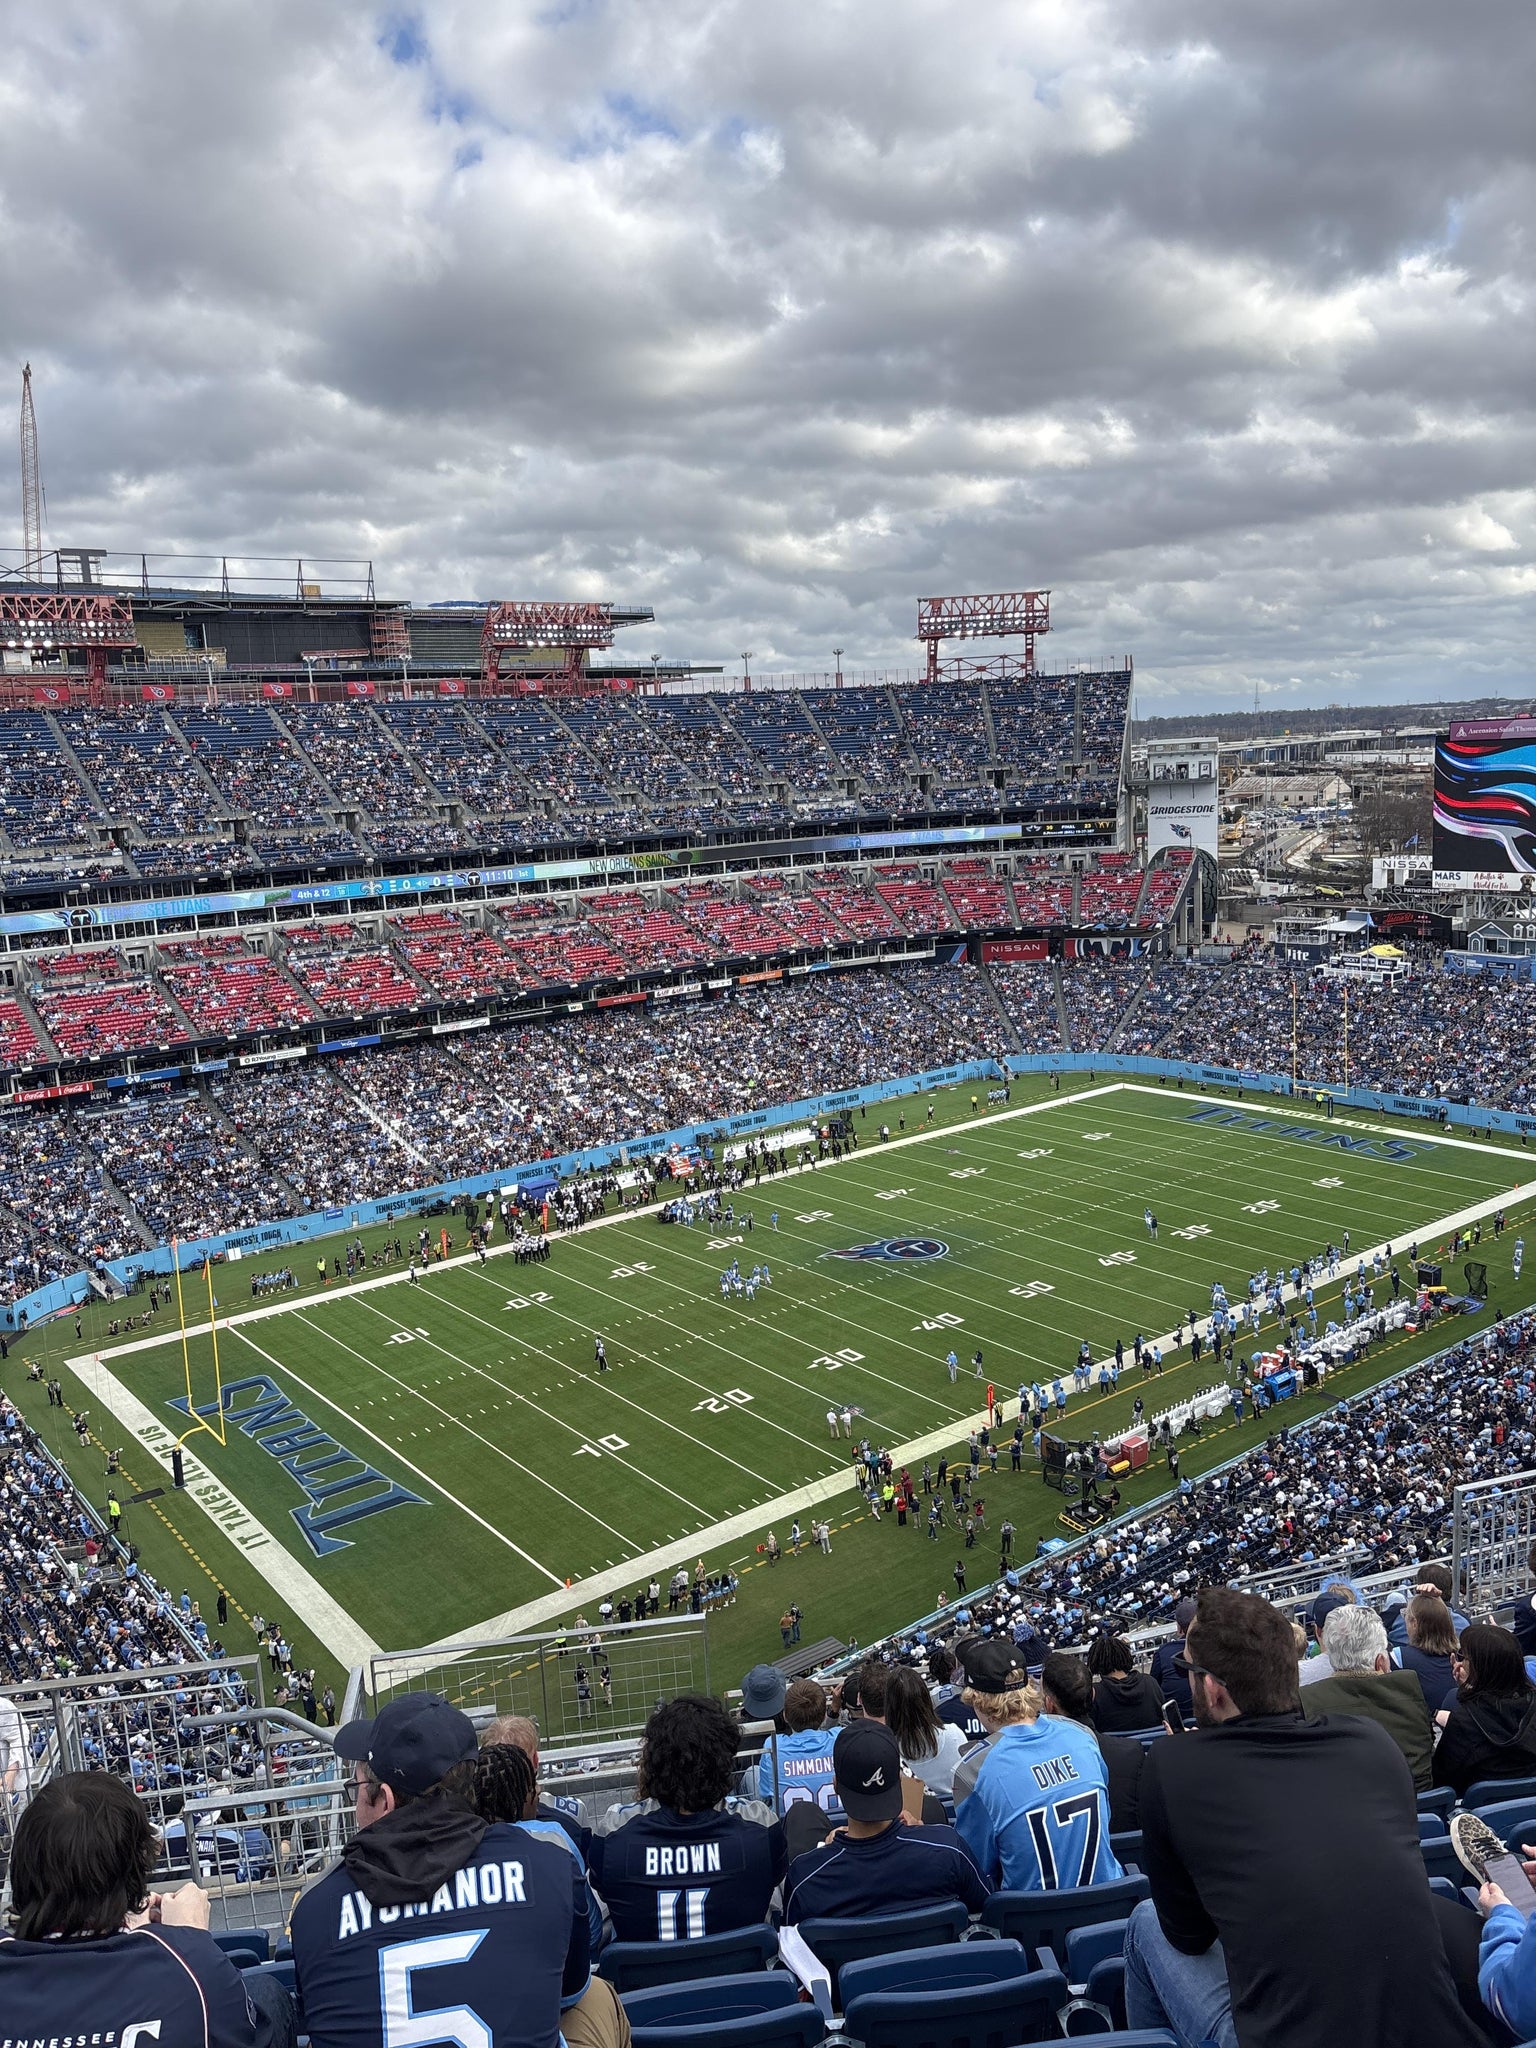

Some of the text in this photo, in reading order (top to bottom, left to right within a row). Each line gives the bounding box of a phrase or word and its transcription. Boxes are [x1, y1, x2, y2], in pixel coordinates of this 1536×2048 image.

[1468, 727, 1498, 735] Ascension
[1150, 804, 1216, 815] BRIDGESTONE
[589, 853, 672, 873] NEW ORLEANS SAINTS
[433, 877, 441, 887] 0
[485, 869, 529, 882] 11:10 1st
[1435, 872, 1461, 881] MARS
[403, 880, 411, 889] 0
[1404, 887, 1440, 895] PATHFINDER
[1435, 881, 1457, 889] Petcare
[1473, 881, 1490, 889] World
[297, 891, 313, 899] 4th
[321, 888, 331, 897] 12
[170, 898, 211, 914] TITANS
[990, 943, 1041, 954] NISSAN
[927, 1070, 957, 1084] TENNESSEE TOUGH
[1201, 1070, 1224, 1080] TENNESSEE
[1225, 1073, 1239, 1082] TOUGH
[24, 1091, 46, 1101] Coca-Cola
[63, 1085, 84, 1095] Coca-Cola
[90, 1091, 112, 1101] KEITH
[826, 1093, 859, 1107] TENNESSEE TOUGH
[1393, 1099, 1439, 1114] TENNESSEE TOUGH
[730, 1114, 767, 1129] TENNESSEE TOUGH
[1081, 1132, 1109, 1141] 10
[1184, 1103, 1439, 1162] TITANS
[627, 1141, 649, 1154] TENNESSEE
[1016, 1148, 1052, 1160] 20
[516, 1166, 544, 1181] TENNESSEE
[948, 1167, 984, 1179] 30
[1311, 1177, 1345, 1189] 10
[874, 1187, 908, 1200] 40
[1240, 1199, 1282, 1215] 20
[794, 1209, 835, 1225] 50
[260, 1228, 281, 1242] TOUGH
[1170, 1224, 1213, 1240] 30
[706, 1235, 743, 1250] 40
[1098, 1251, 1138, 1267] 40
[614, 1261, 657, 1279] 30
[1007, 1280, 1056, 1299] 50
[505, 1291, 554, 1310] 20
[921, 1312, 966, 1331] 40
[390, 1327, 430, 1344] 10
[813, 1347, 866, 1371] 30
[698, 1388, 755, 1414] 20
[137, 1425, 168, 1443] US
[580, 1433, 630, 1457] 10
[165, 1374, 433, 1559] TITANS
[195, 1484, 251, 1532] TAKES
[237, 1531, 271, 1550] IT
[783, 1757, 835, 1777] SIMMON
[1030, 1754, 1080, 1792] DIKE
[862, 1766, 885, 1788] A
[1025, 1788, 1101, 1891] 17
[645, 1842, 721, 1876] BROWN
[656, 1887, 711, 1942] 11
[377, 1928, 493, 2048] 5
[0, 2031, 116, 2048] ENNESSEE
